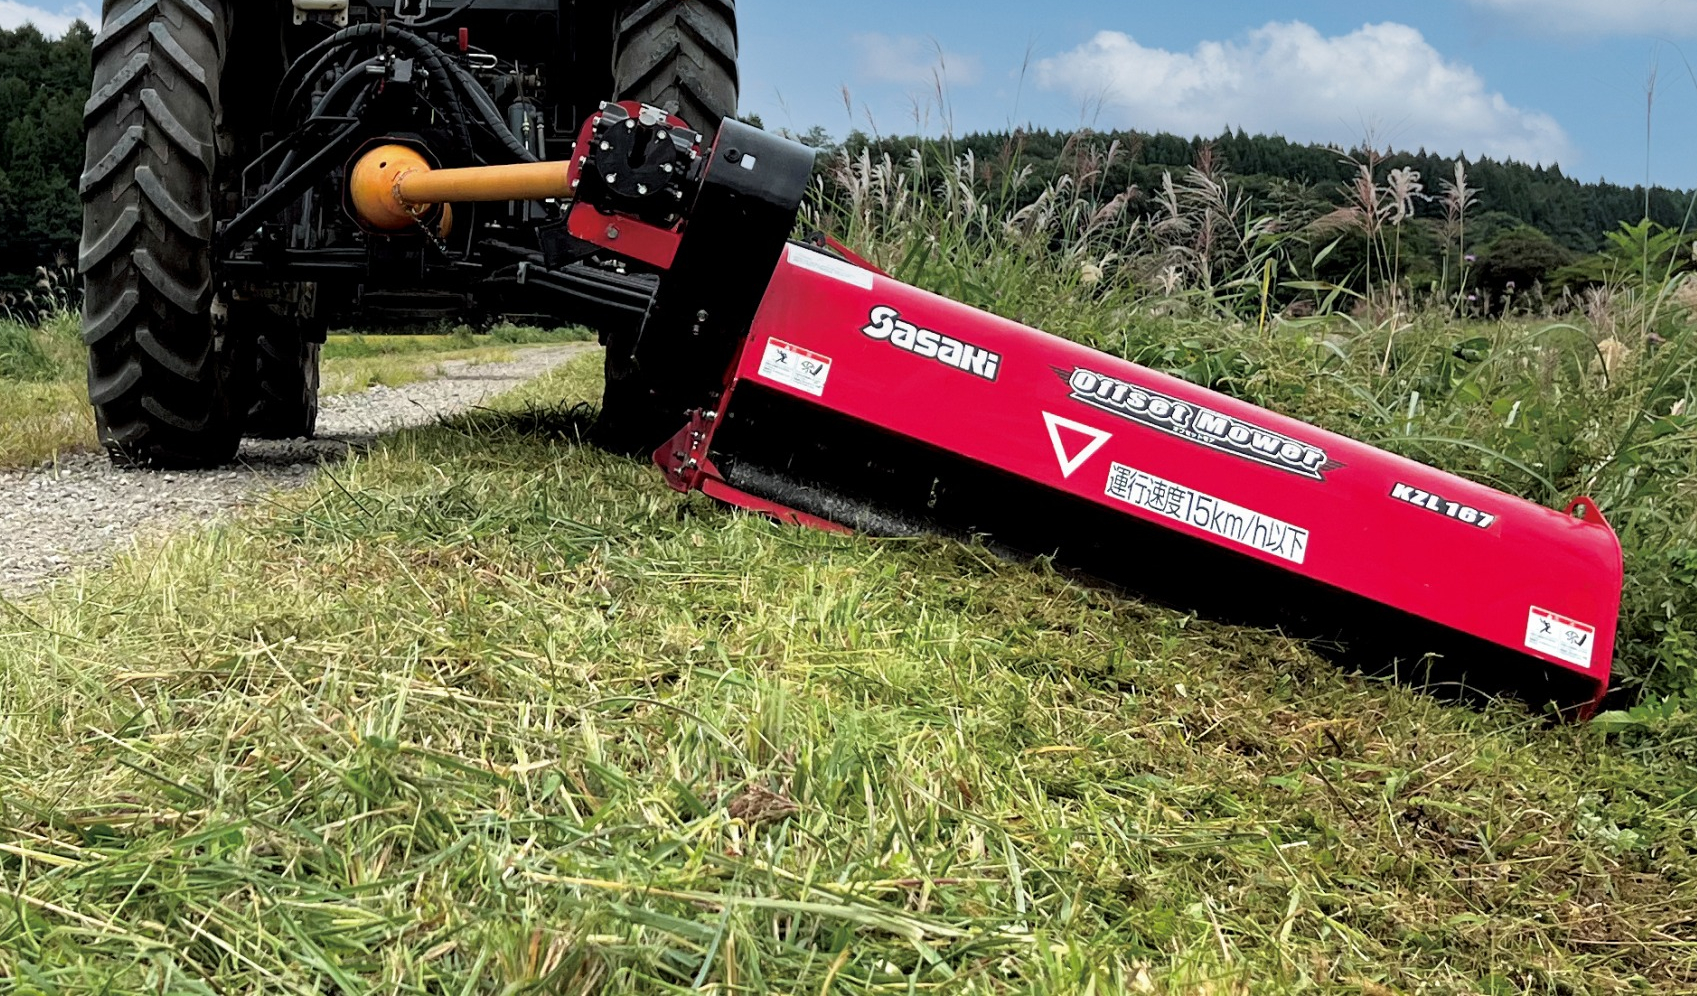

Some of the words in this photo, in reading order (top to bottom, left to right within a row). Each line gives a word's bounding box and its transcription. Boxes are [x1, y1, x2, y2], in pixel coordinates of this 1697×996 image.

[862, 305, 1001, 381] Sasaki
[1070, 370, 1192, 427] Offset
[1193, 409, 1326, 470] Mower
[1107, 465, 1306, 558] 運行速度15km/h以下
[1391, 483, 1440, 511] KZL
[1445, 502, 1495, 528] 167
